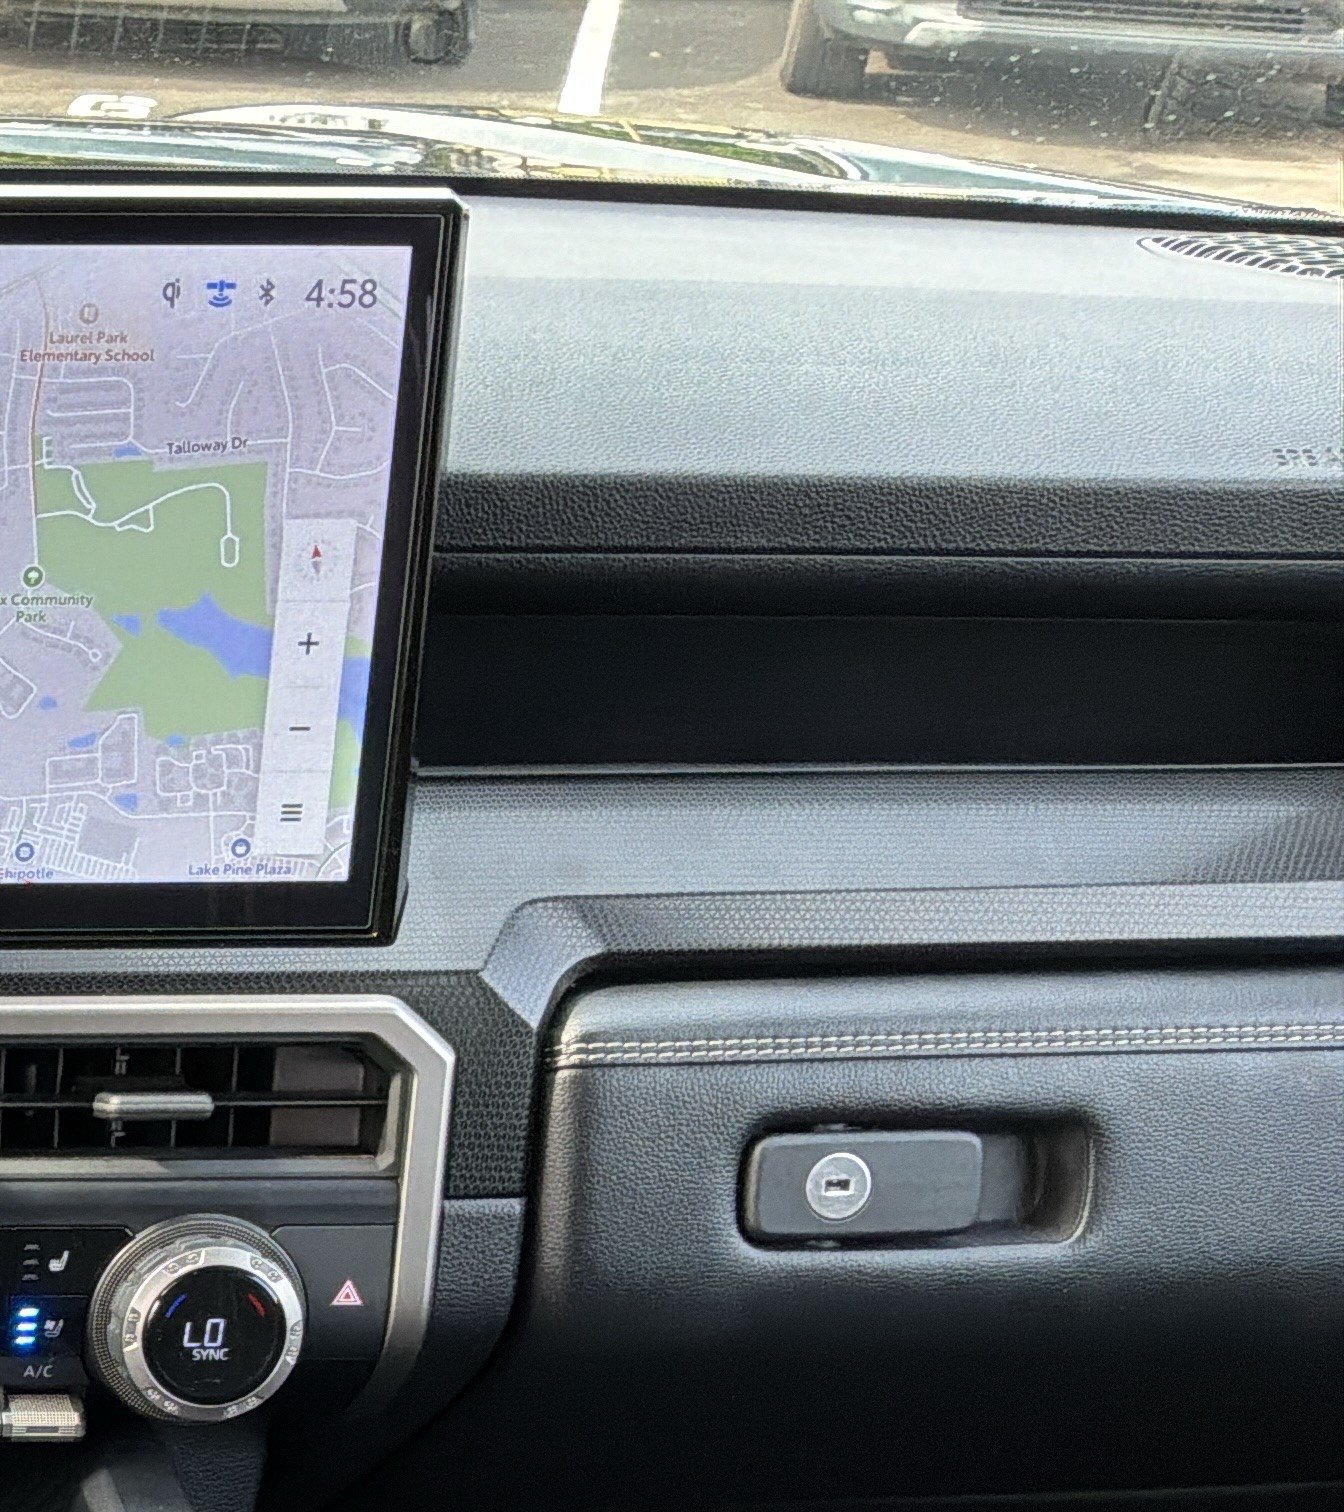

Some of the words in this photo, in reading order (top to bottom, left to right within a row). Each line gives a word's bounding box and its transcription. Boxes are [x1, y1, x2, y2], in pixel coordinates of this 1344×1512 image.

[305, 278, 378, 308] 4:58
[49, 331, 93, 344] Laurel
[96, 331, 128, 344] Park
[20, 350, 103, 365] Elementary
[105, 348, 155, 363] School
[166, 437, 228, 456] Talloway
[230, 436, 250, 450] Dr
[10, 593, 94, 609] Community
[15, 610, 47, 623] Park
[188, 864, 221, 877] Lake
[223, 864, 251, 877] Pine
[253, 864, 292, 877] Plaza
[182, 1318, 226, 1348] LO
[192, 1348, 230, 1361] SYNC
[23, 1364, 54, 1380] A/C
